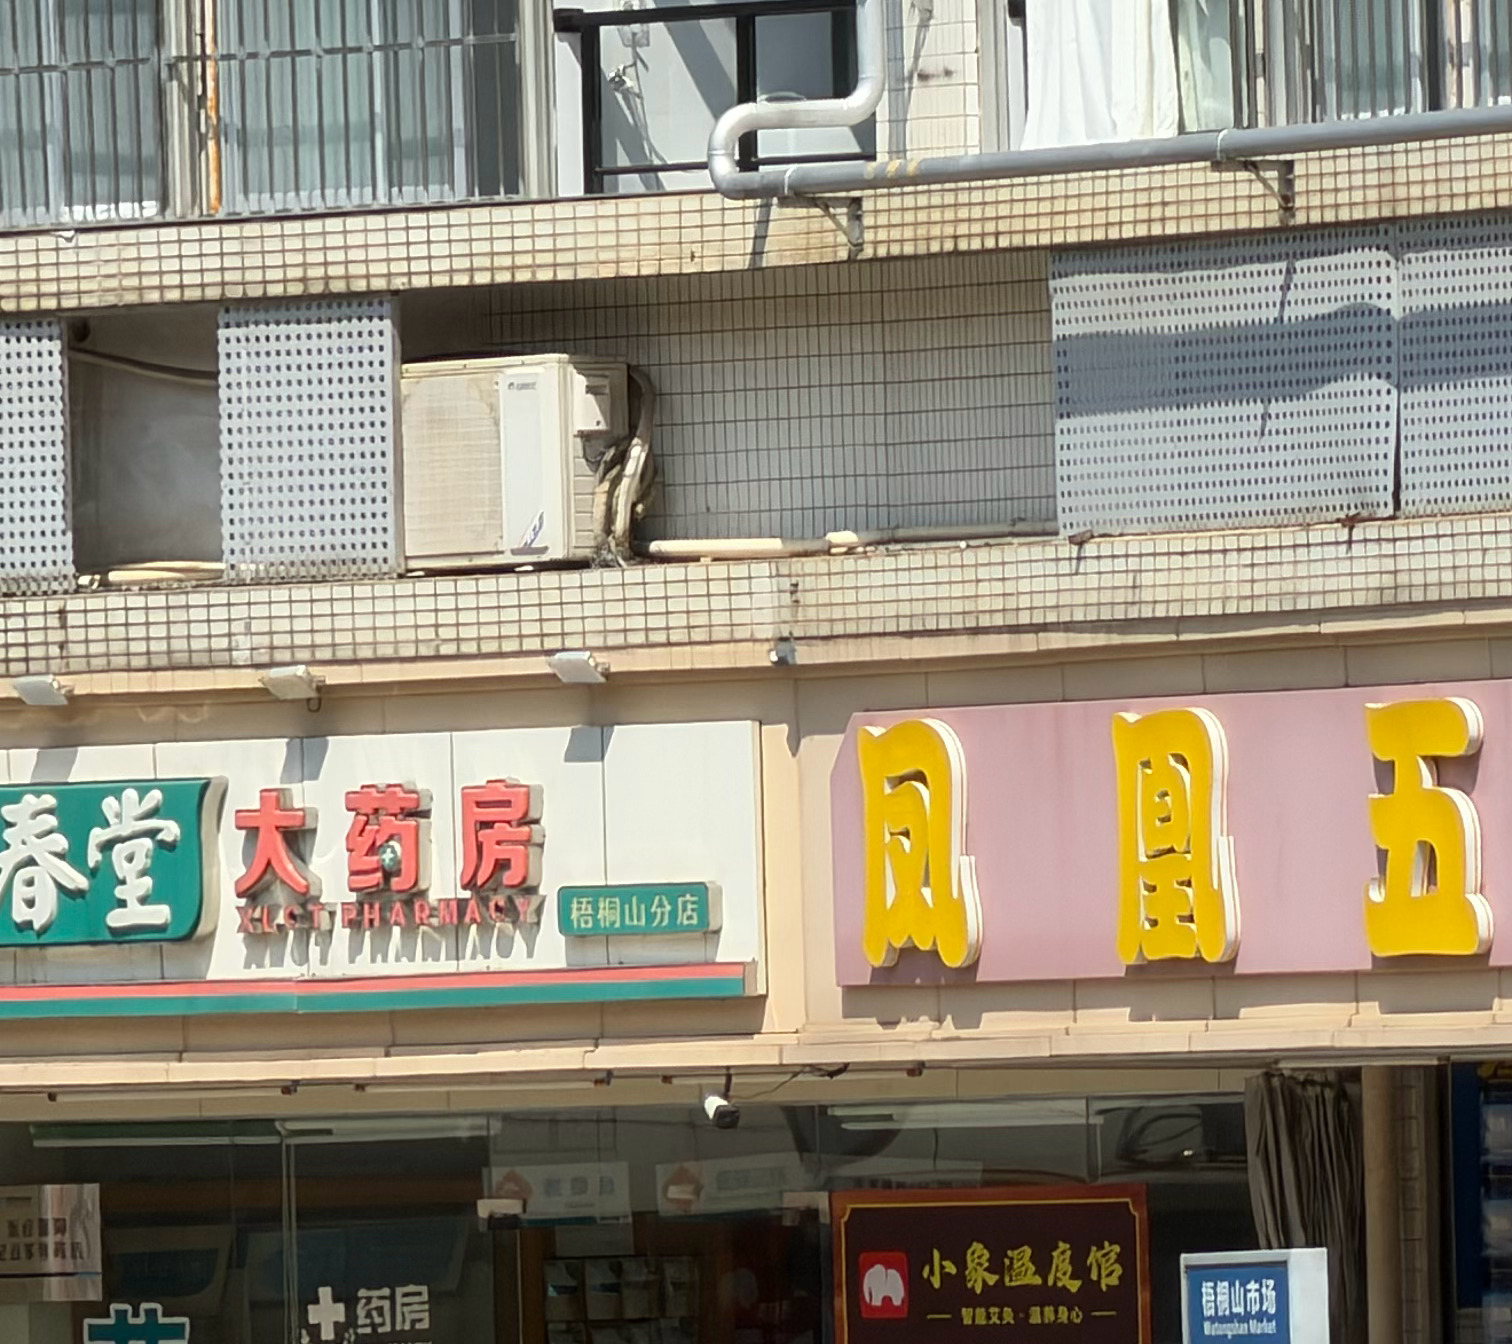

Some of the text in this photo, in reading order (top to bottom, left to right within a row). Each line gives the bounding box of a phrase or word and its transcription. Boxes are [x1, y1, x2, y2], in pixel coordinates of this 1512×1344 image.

[0, 787, 182, 932] 春堂
[235, 777, 534, 899] 大药房
[235, 896, 534, 934] XLCT PHARMACY
[569, 894, 700, 930] 梧桐山分店
[355, 1284, 431, 1334] 药房
[1201, 1278, 1277, 1318] 梧桐山市场
